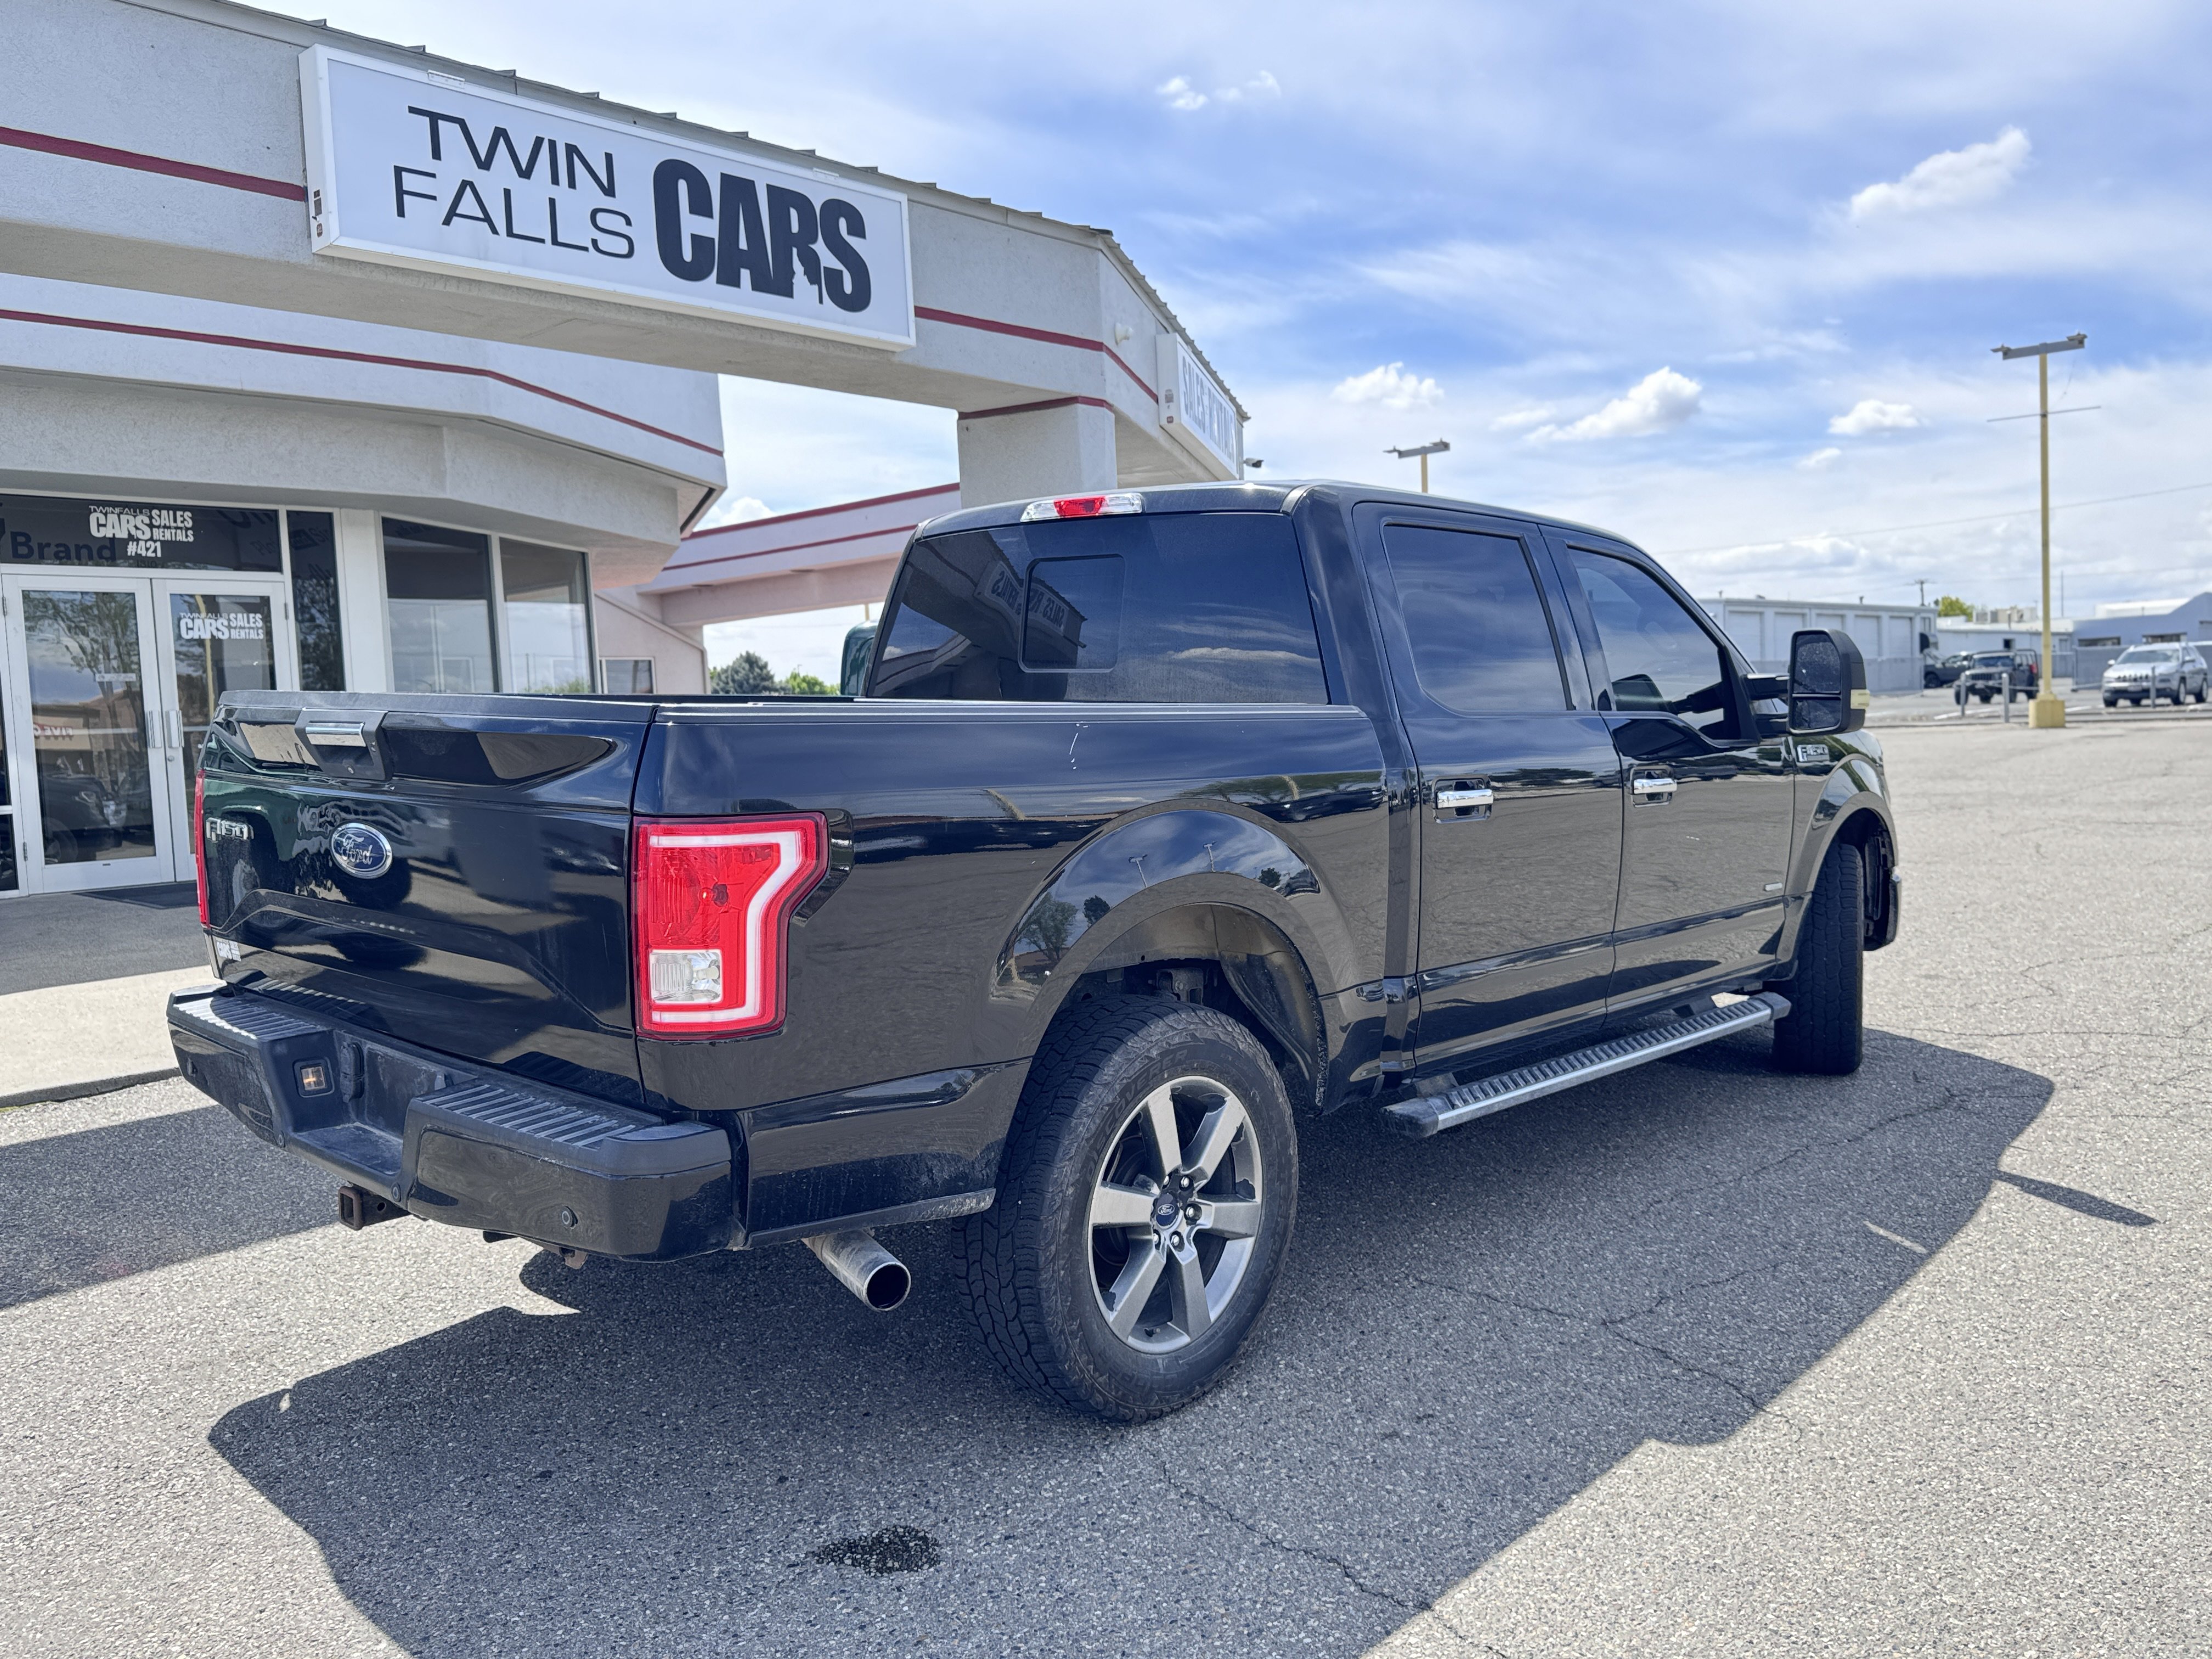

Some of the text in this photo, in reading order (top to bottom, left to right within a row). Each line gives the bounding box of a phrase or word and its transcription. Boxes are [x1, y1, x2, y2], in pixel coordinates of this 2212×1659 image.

[407, 105, 616, 198] TWIN
[393, 164, 634, 258] FALLS
[653, 159, 871, 312] CARS
[89, 512, 151, 540] CARS
[151, 509, 193, 528] SALES
[10, 531, 116, 562] Brand
[127, 540, 161, 557] #421
[153, 528, 194, 542] RENTALS
[180, 618, 229, 640] CARS
[229, 613, 263, 627] SALES
[230, 628, 264, 639] RENTALS
[337, 833, 373, 865] Ford
[1085, 1048, 1188, 1178] DISCOVERER
